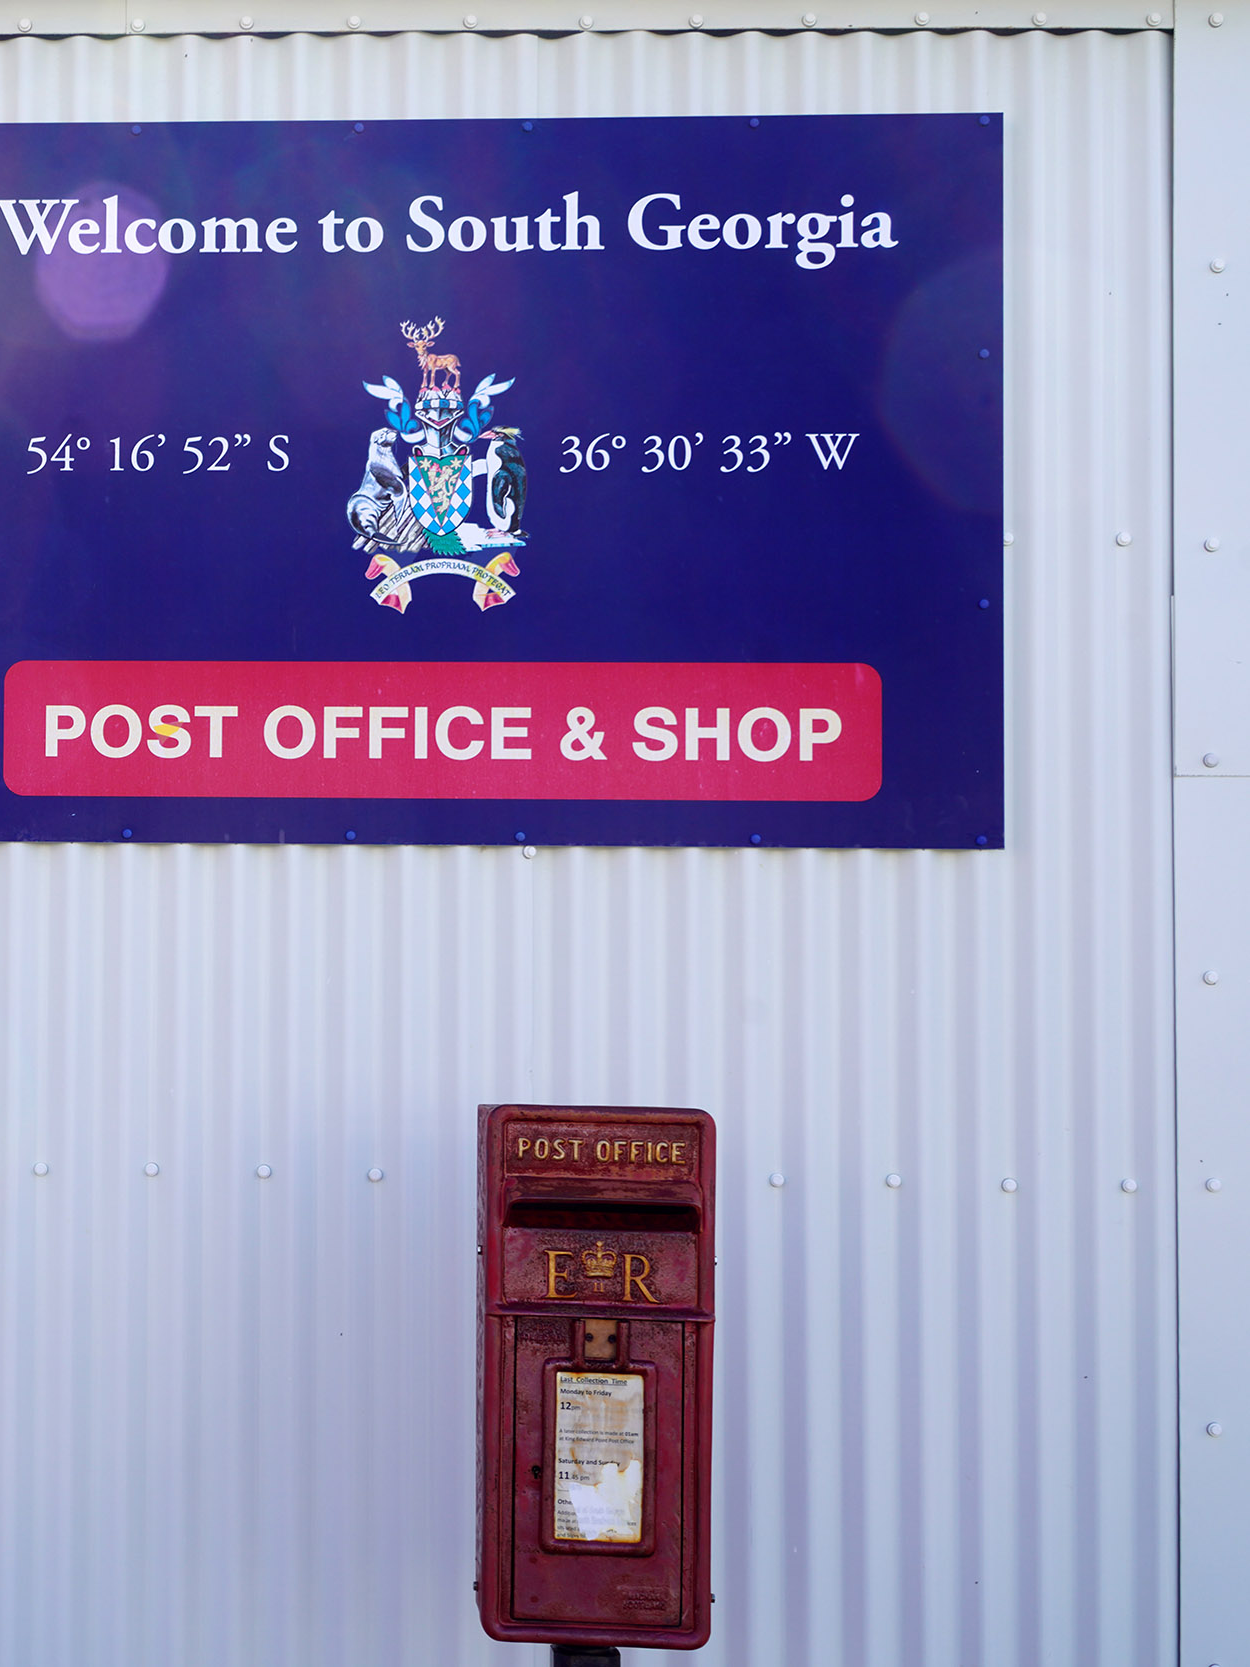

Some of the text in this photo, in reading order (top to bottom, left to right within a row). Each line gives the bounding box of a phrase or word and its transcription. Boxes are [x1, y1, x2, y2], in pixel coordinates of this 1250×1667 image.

[318, 210, 384, 253] to
[407, 191, 605, 253] South
[628, 193, 899, 270] Georgia
[267, 434, 290, 472] S
[805, 433, 860, 470] W
[375, 583, 390, 599] LEO
[390, 564, 425, 585] TERRAM
[425, 561, 471, 572] PROPRIAM
[45, 704, 842, 762] POST OFFICE & SHOP
[517, 1137, 687, 1164] POST OFFICE
[544, 1249, 661, 1303] E R
[560, 1376, 628, 1386] Last Collection Time
[560, 1388, 585, 1396] Monday
[593, 1389, 612, 1397] Friday
